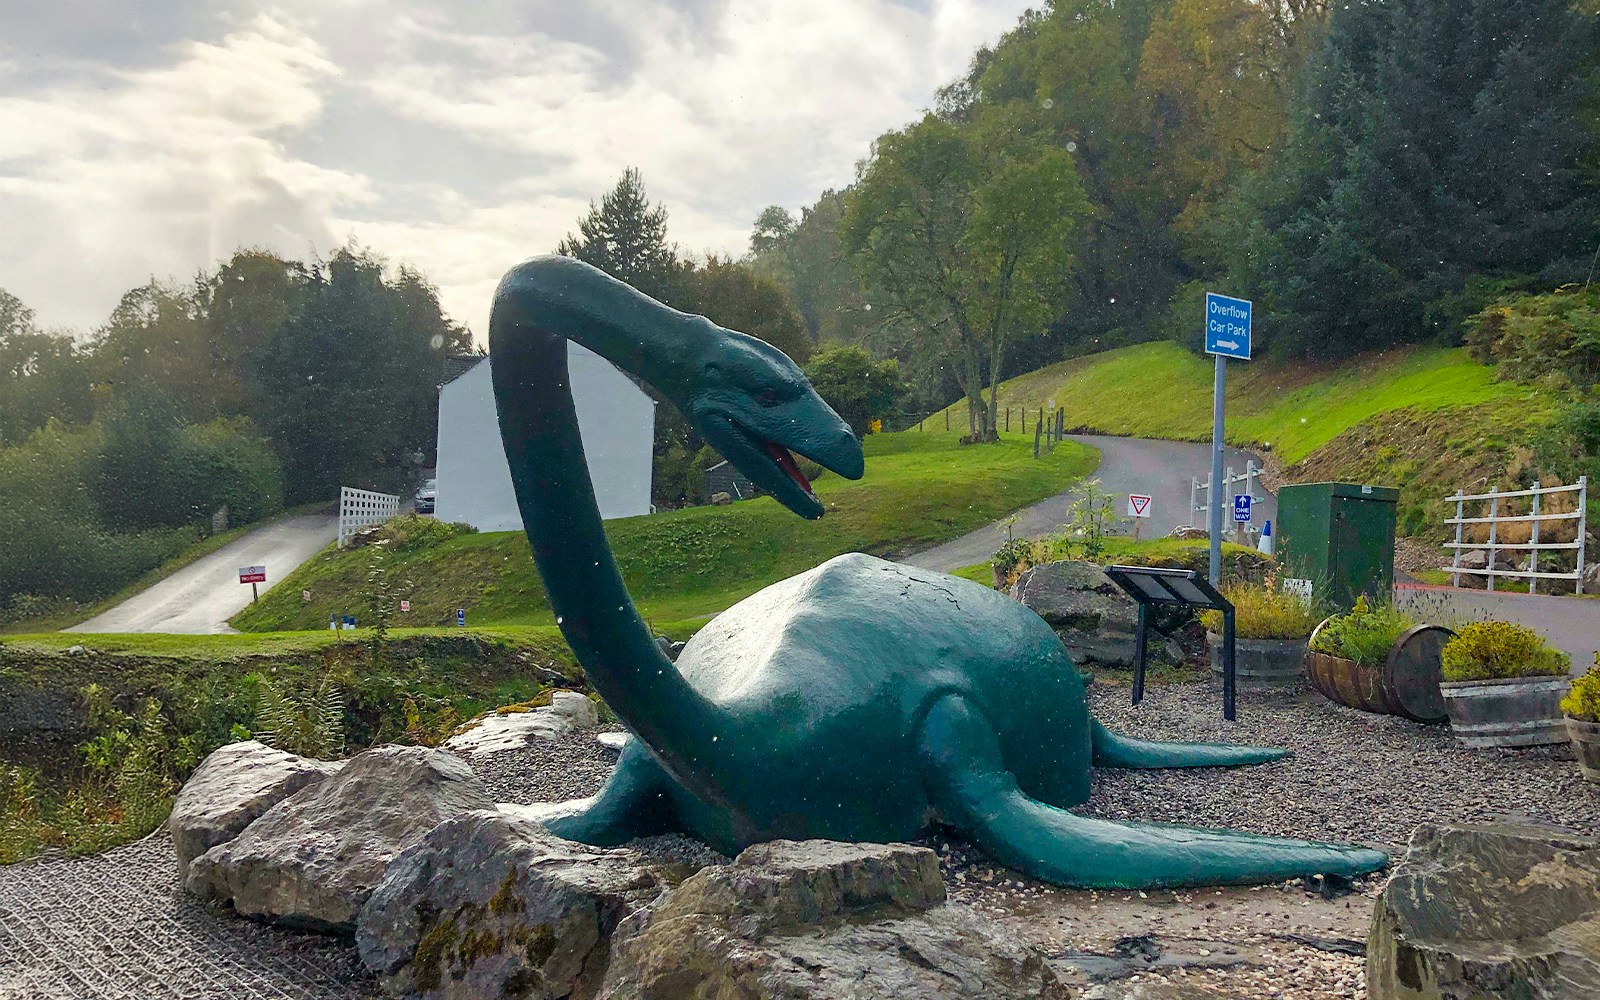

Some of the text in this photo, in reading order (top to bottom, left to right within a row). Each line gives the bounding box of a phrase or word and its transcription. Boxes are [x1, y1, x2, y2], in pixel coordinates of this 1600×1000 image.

[1210, 302, 1248, 319] Overflow
[1210, 320, 1247, 337] Car Park
